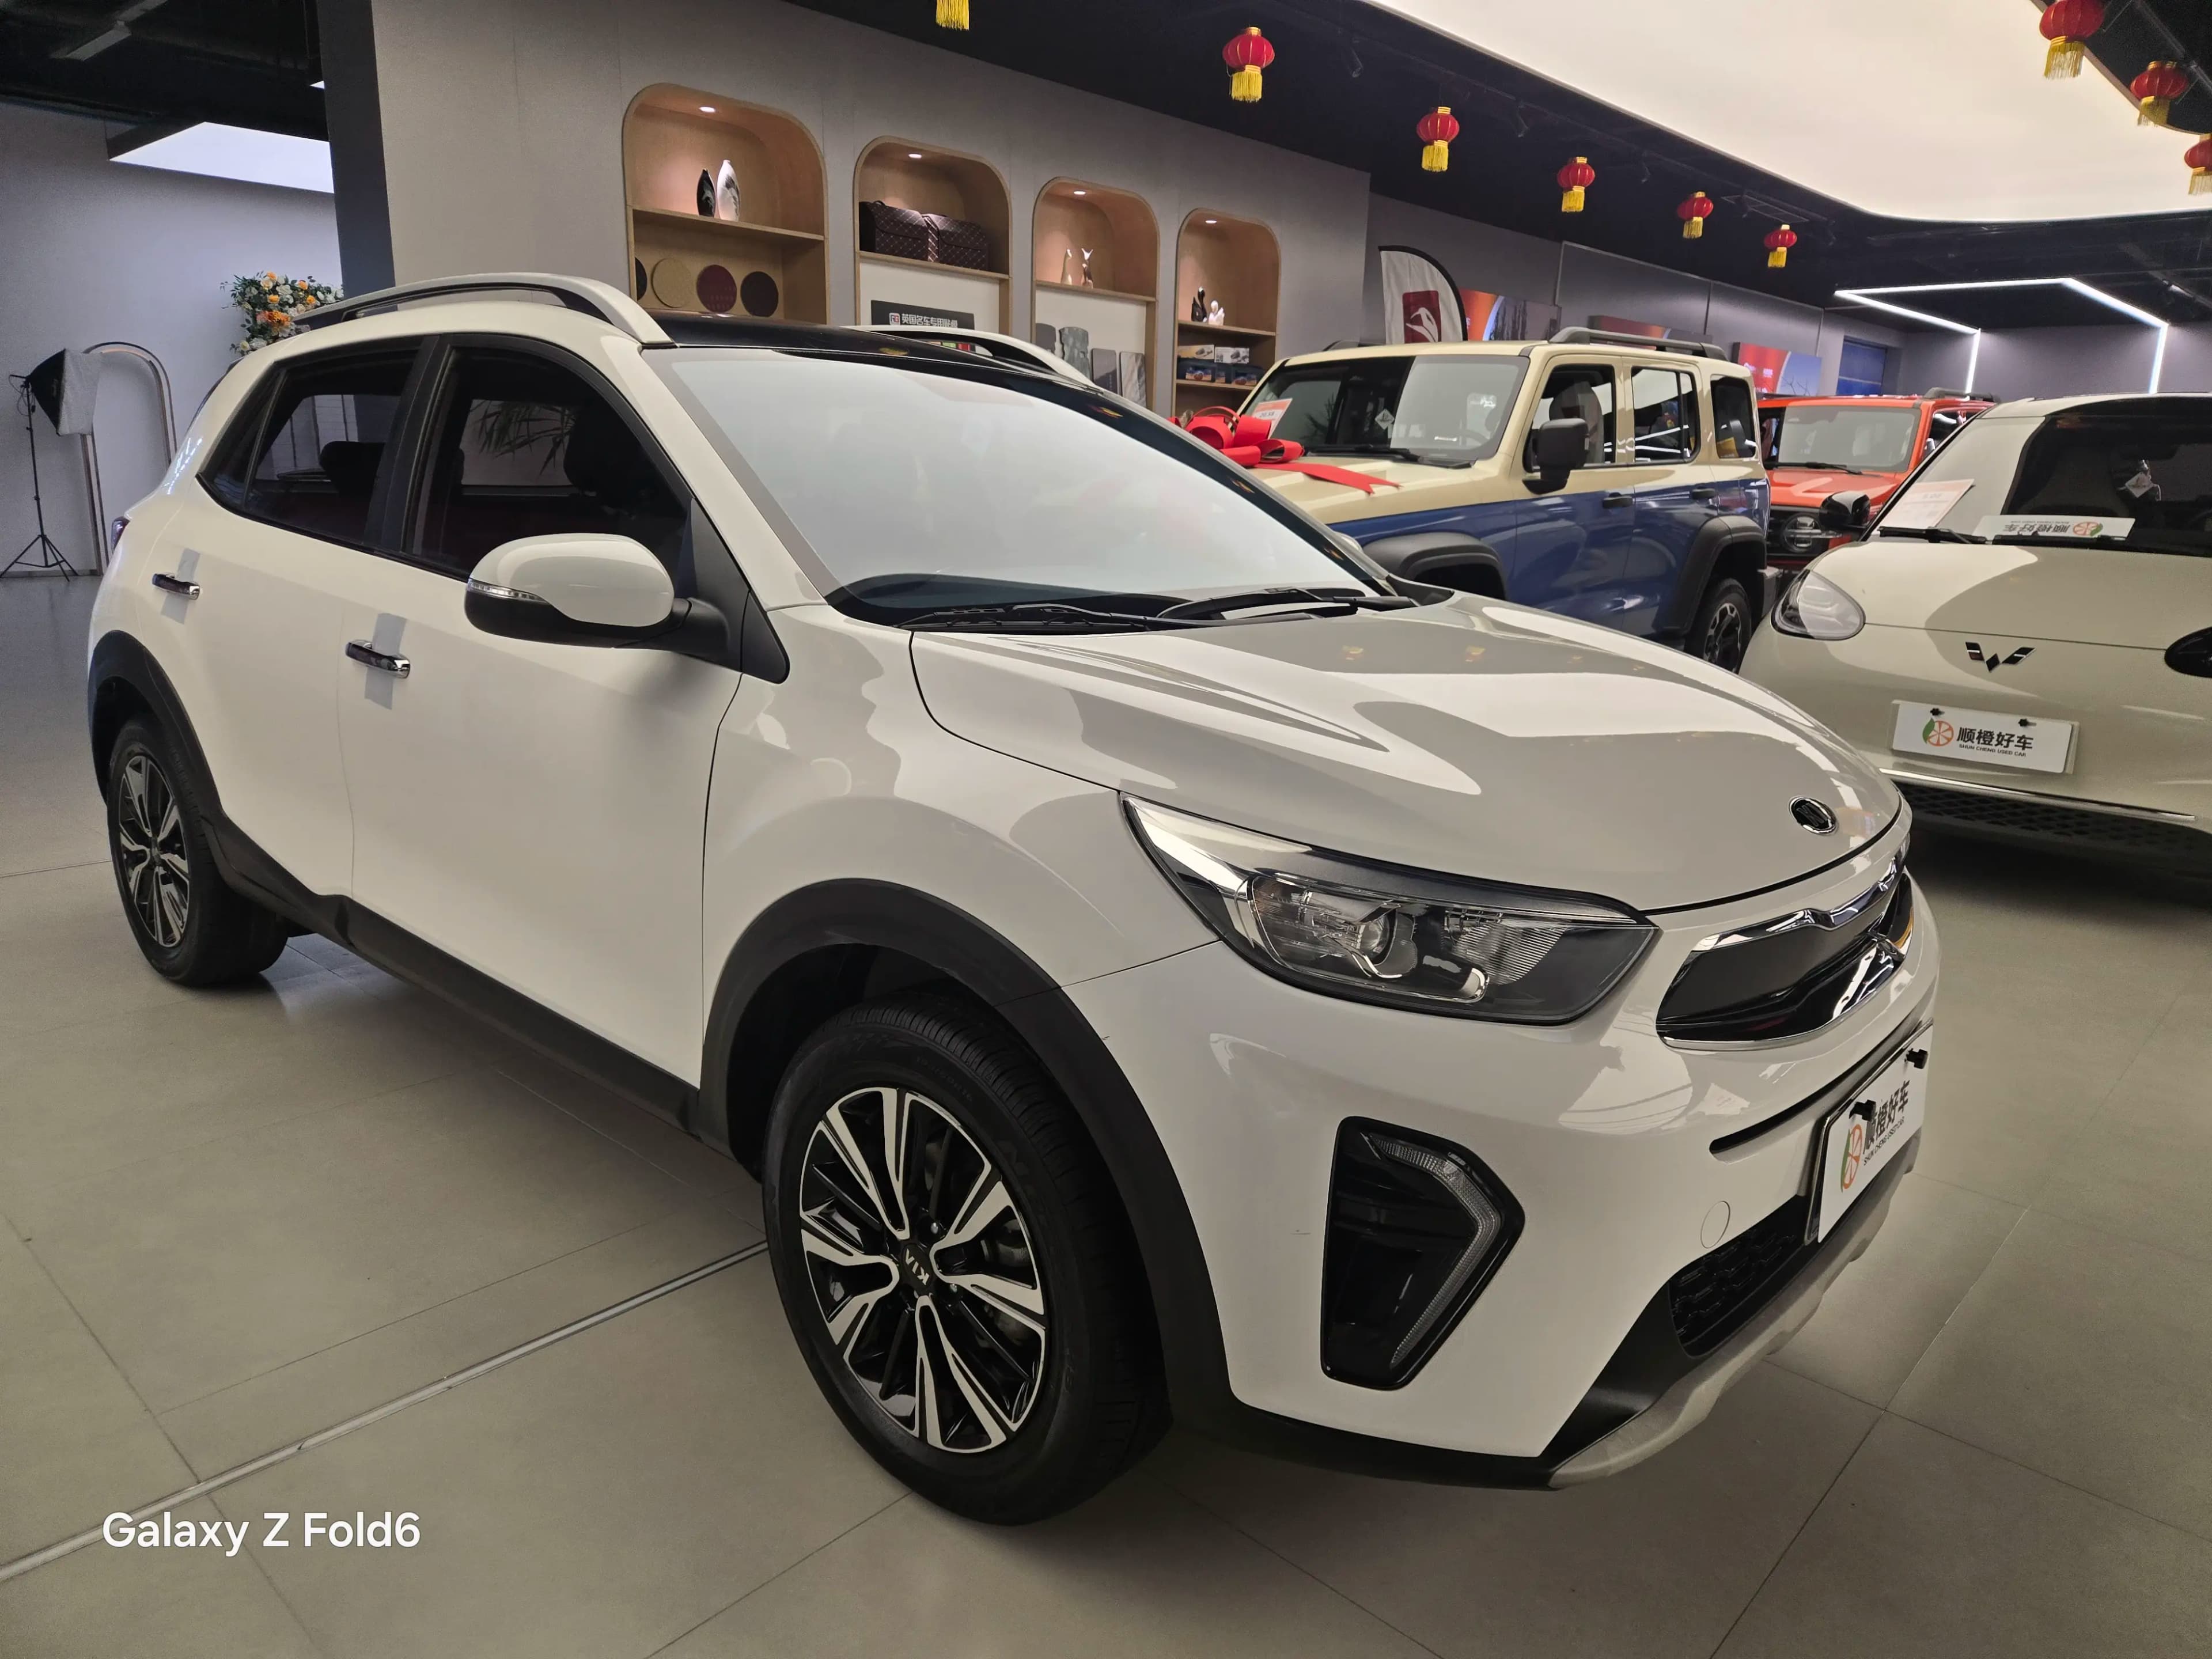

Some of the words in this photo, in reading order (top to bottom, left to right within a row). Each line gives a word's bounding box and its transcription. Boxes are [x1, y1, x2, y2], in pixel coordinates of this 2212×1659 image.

[1957, 726, 2034, 751] 顺橙好车
[905, 1248, 930, 1286] KIA
